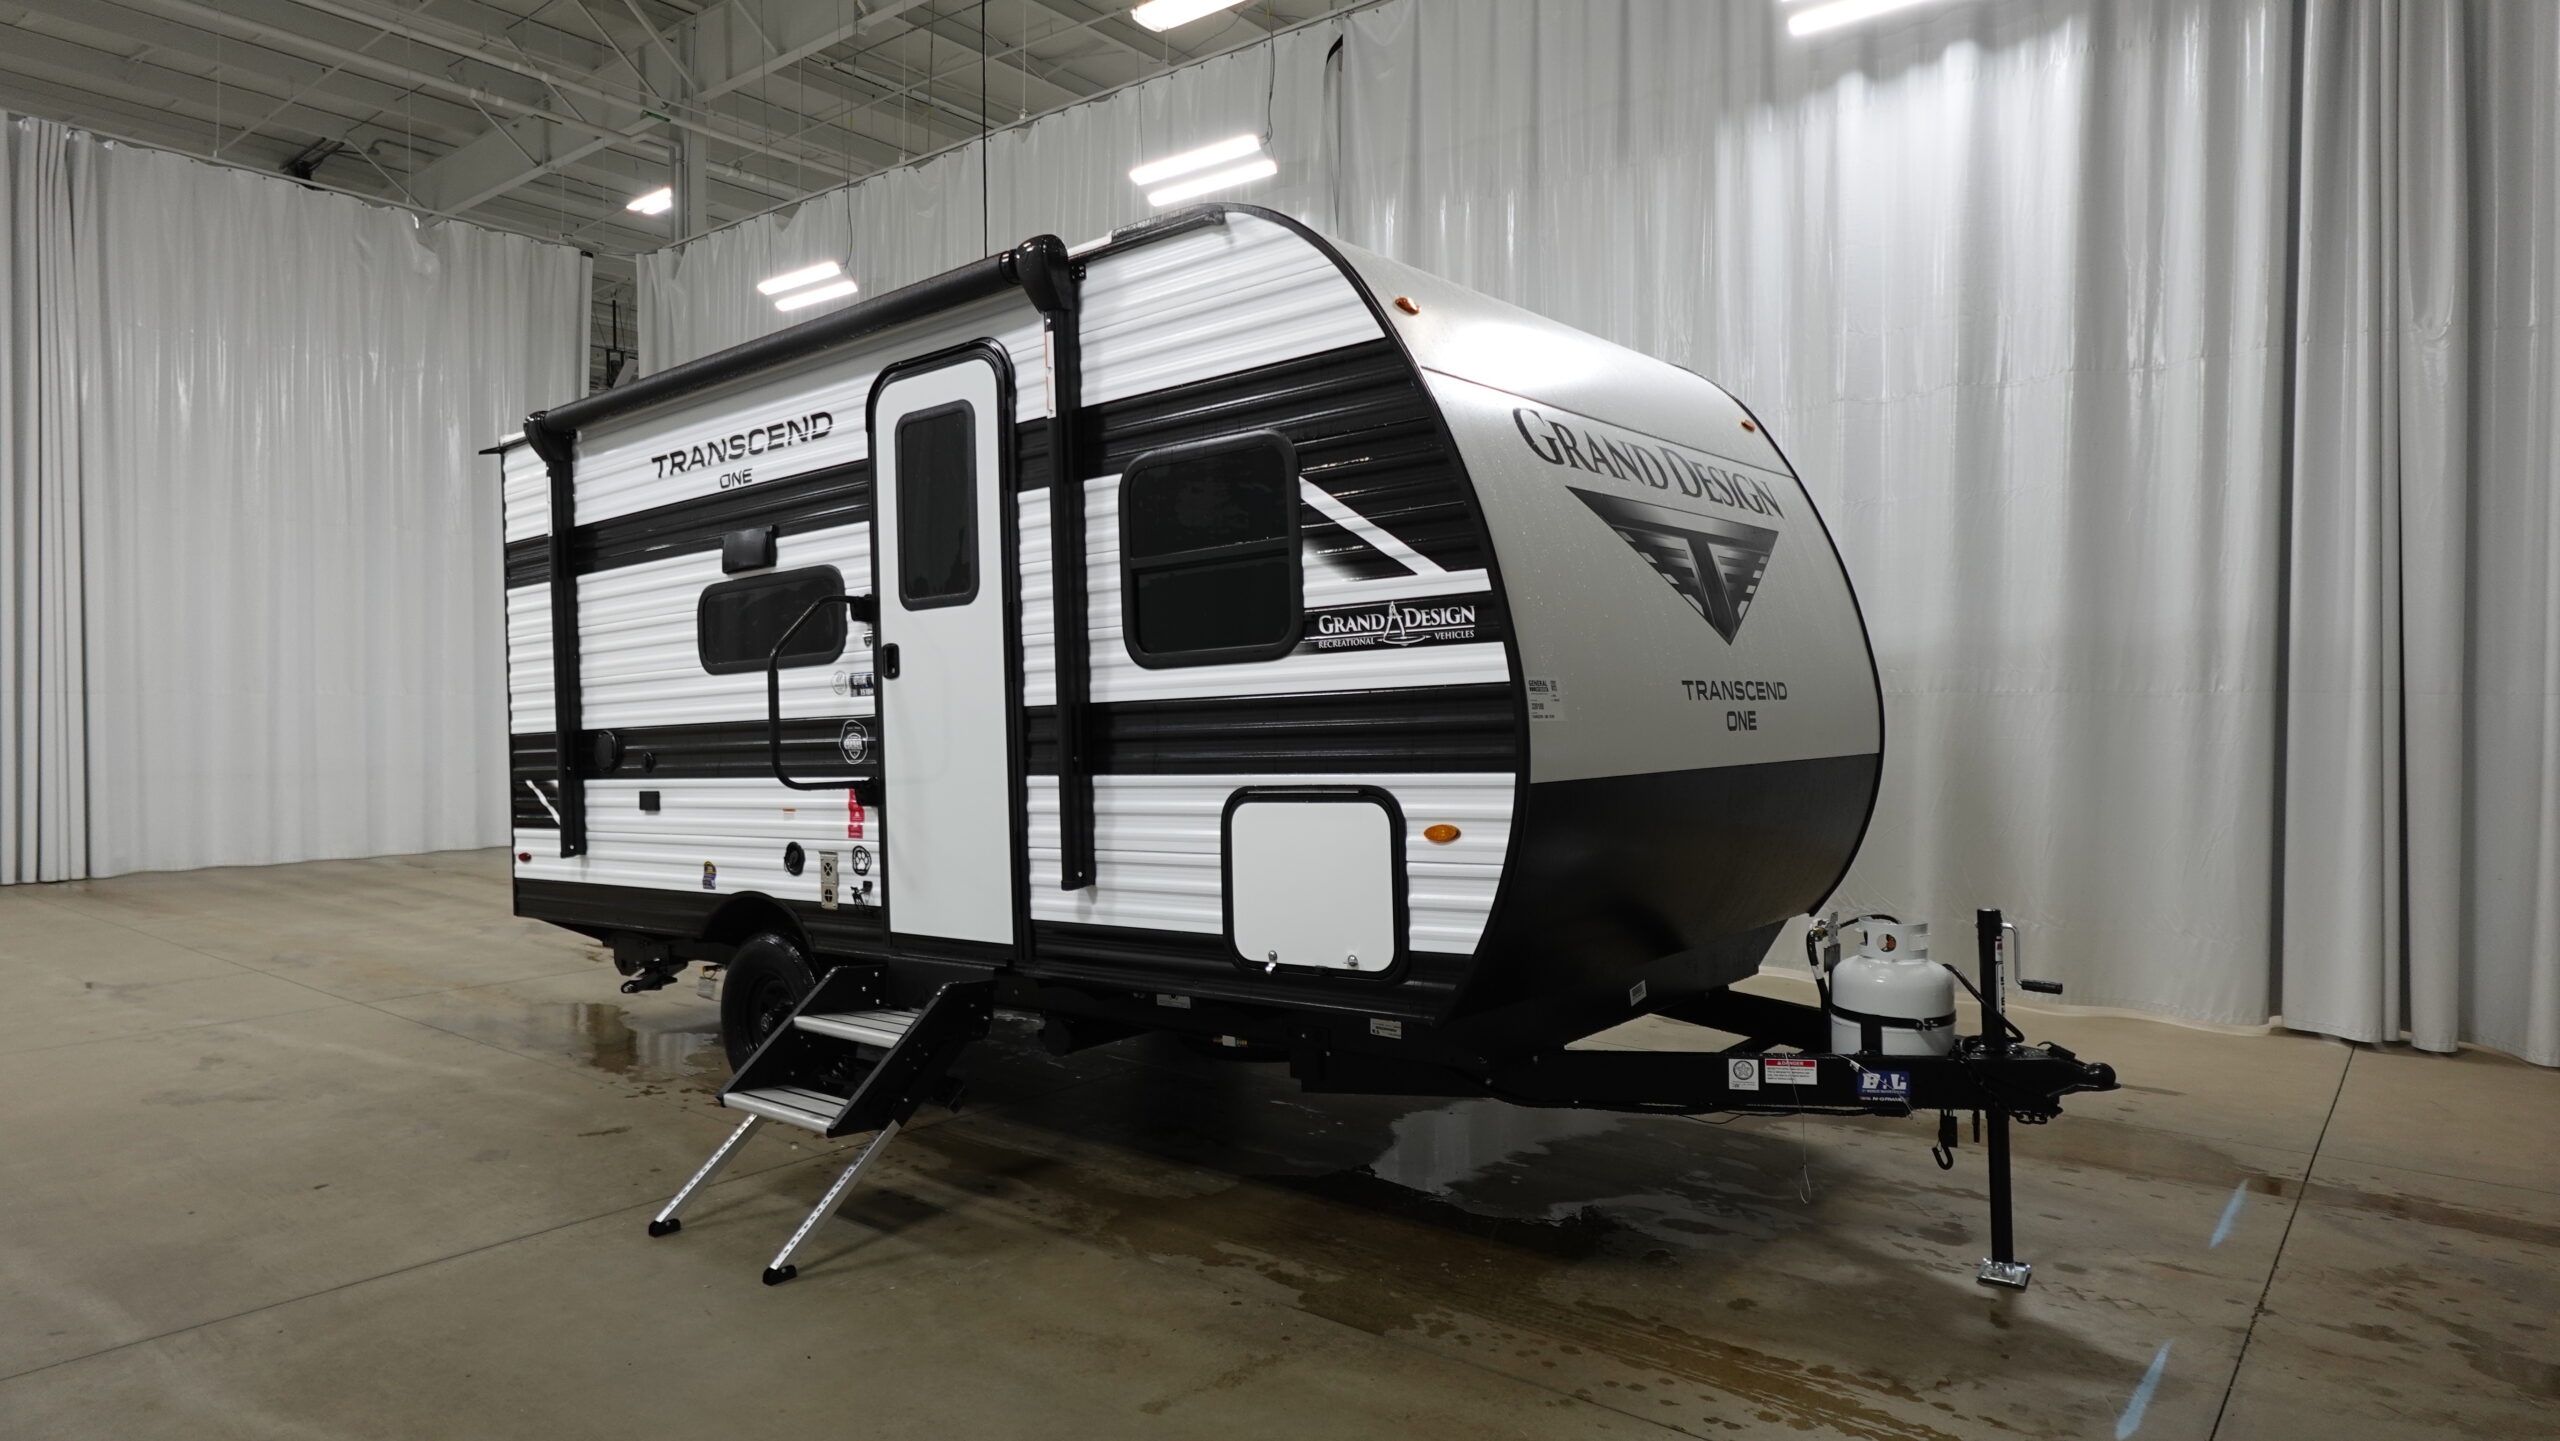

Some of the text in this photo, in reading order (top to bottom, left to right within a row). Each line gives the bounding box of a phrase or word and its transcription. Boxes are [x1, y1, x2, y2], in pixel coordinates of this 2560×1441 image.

[651, 411, 833, 479] TRANSCEND
[1512, 407, 1785, 520] GRAND DESIGN
[719, 468, 753, 489] ONE
[1318, 605, 1476, 635] GRAND DESIGN
[1317, 629, 1475, 649] RECREATIONAL VEHICLES
[1681, 679, 1788, 701] TRANSCEND
[1726, 710, 1758, 732] ONE
